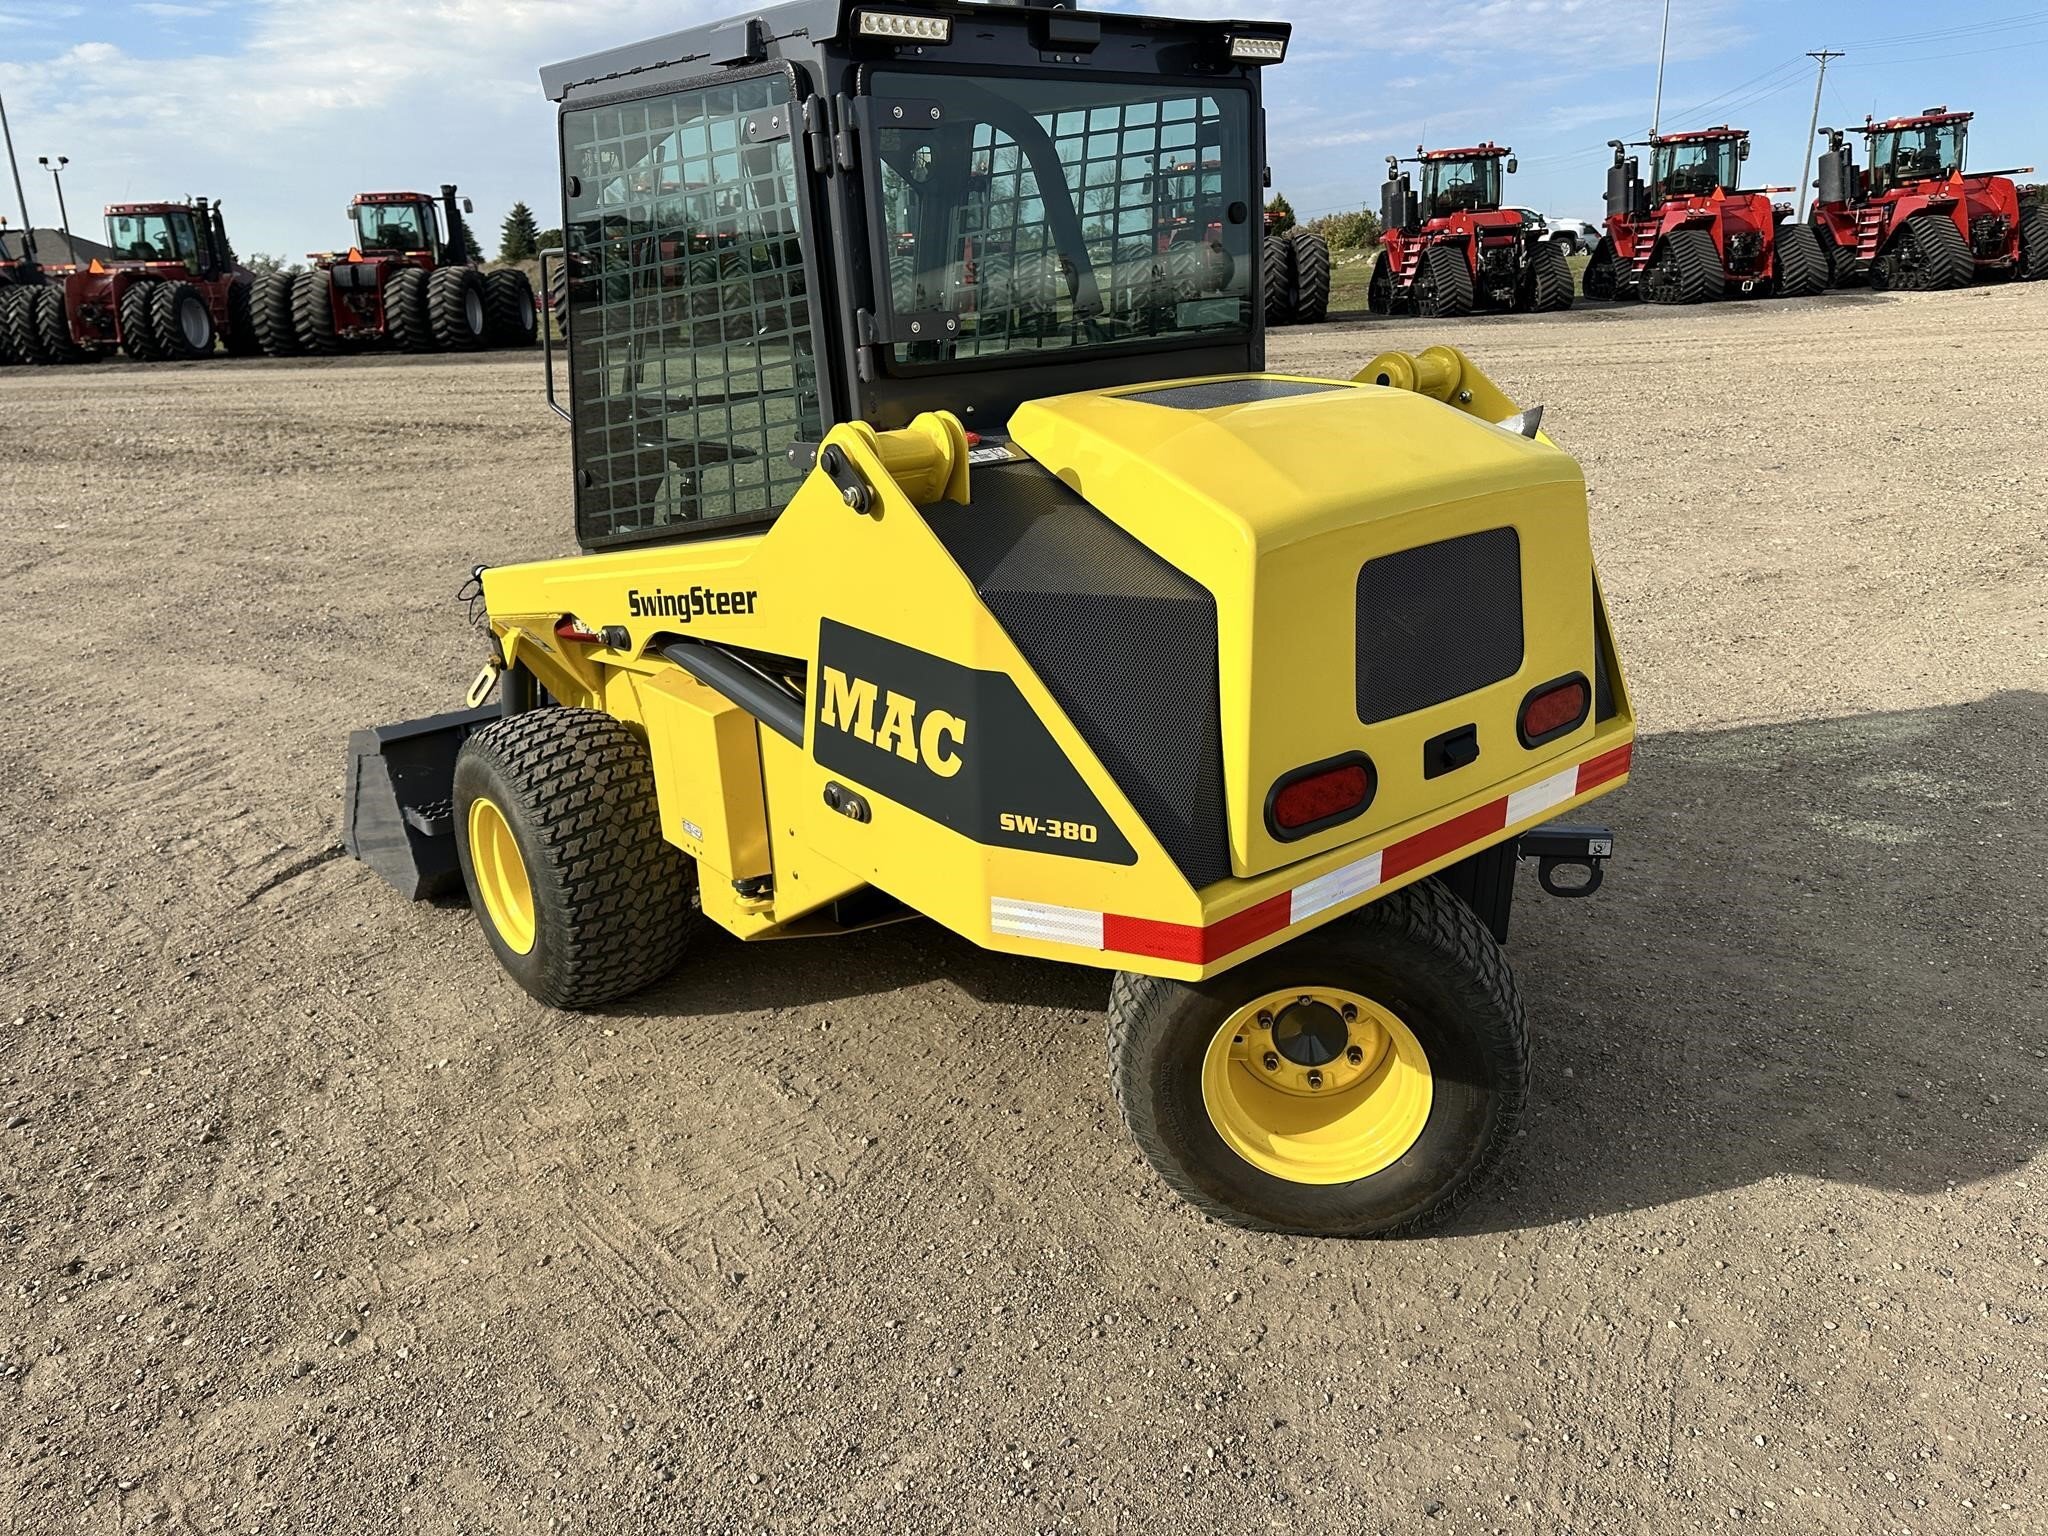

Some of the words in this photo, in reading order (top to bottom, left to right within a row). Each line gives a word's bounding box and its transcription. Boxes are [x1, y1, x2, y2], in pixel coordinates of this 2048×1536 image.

[628, 586, 757, 623] SwingSteer
[821, 665, 966, 778] MAC
[1000, 813, 1097, 843] SW-380
